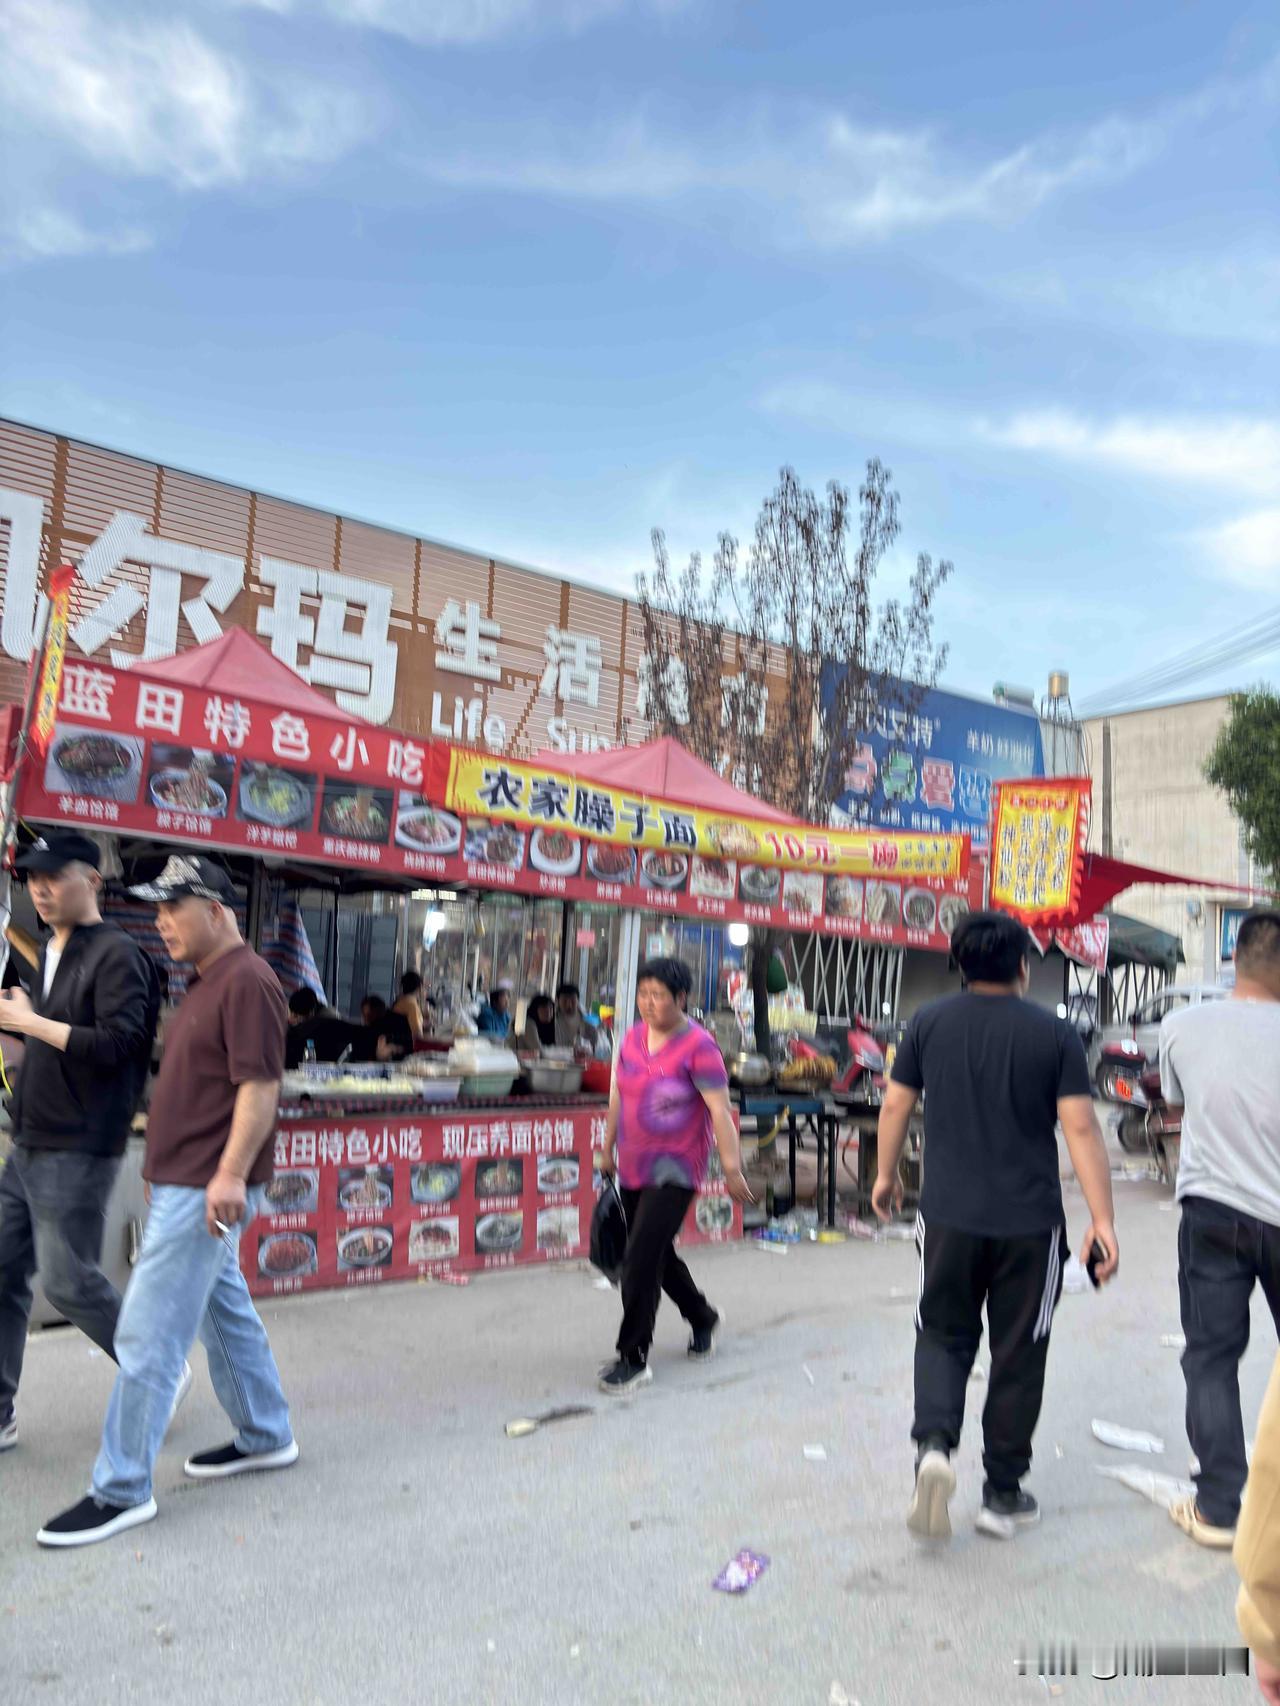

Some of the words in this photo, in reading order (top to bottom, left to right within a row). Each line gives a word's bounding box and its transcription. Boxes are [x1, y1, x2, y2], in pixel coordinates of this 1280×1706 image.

[59, 664, 425, 787] 蓝田特色小吃
[431, 690, 506, 753] Life
[477, 764, 699, 851] 农家臊子面
[763, 831, 900, 870] 10元一碗
